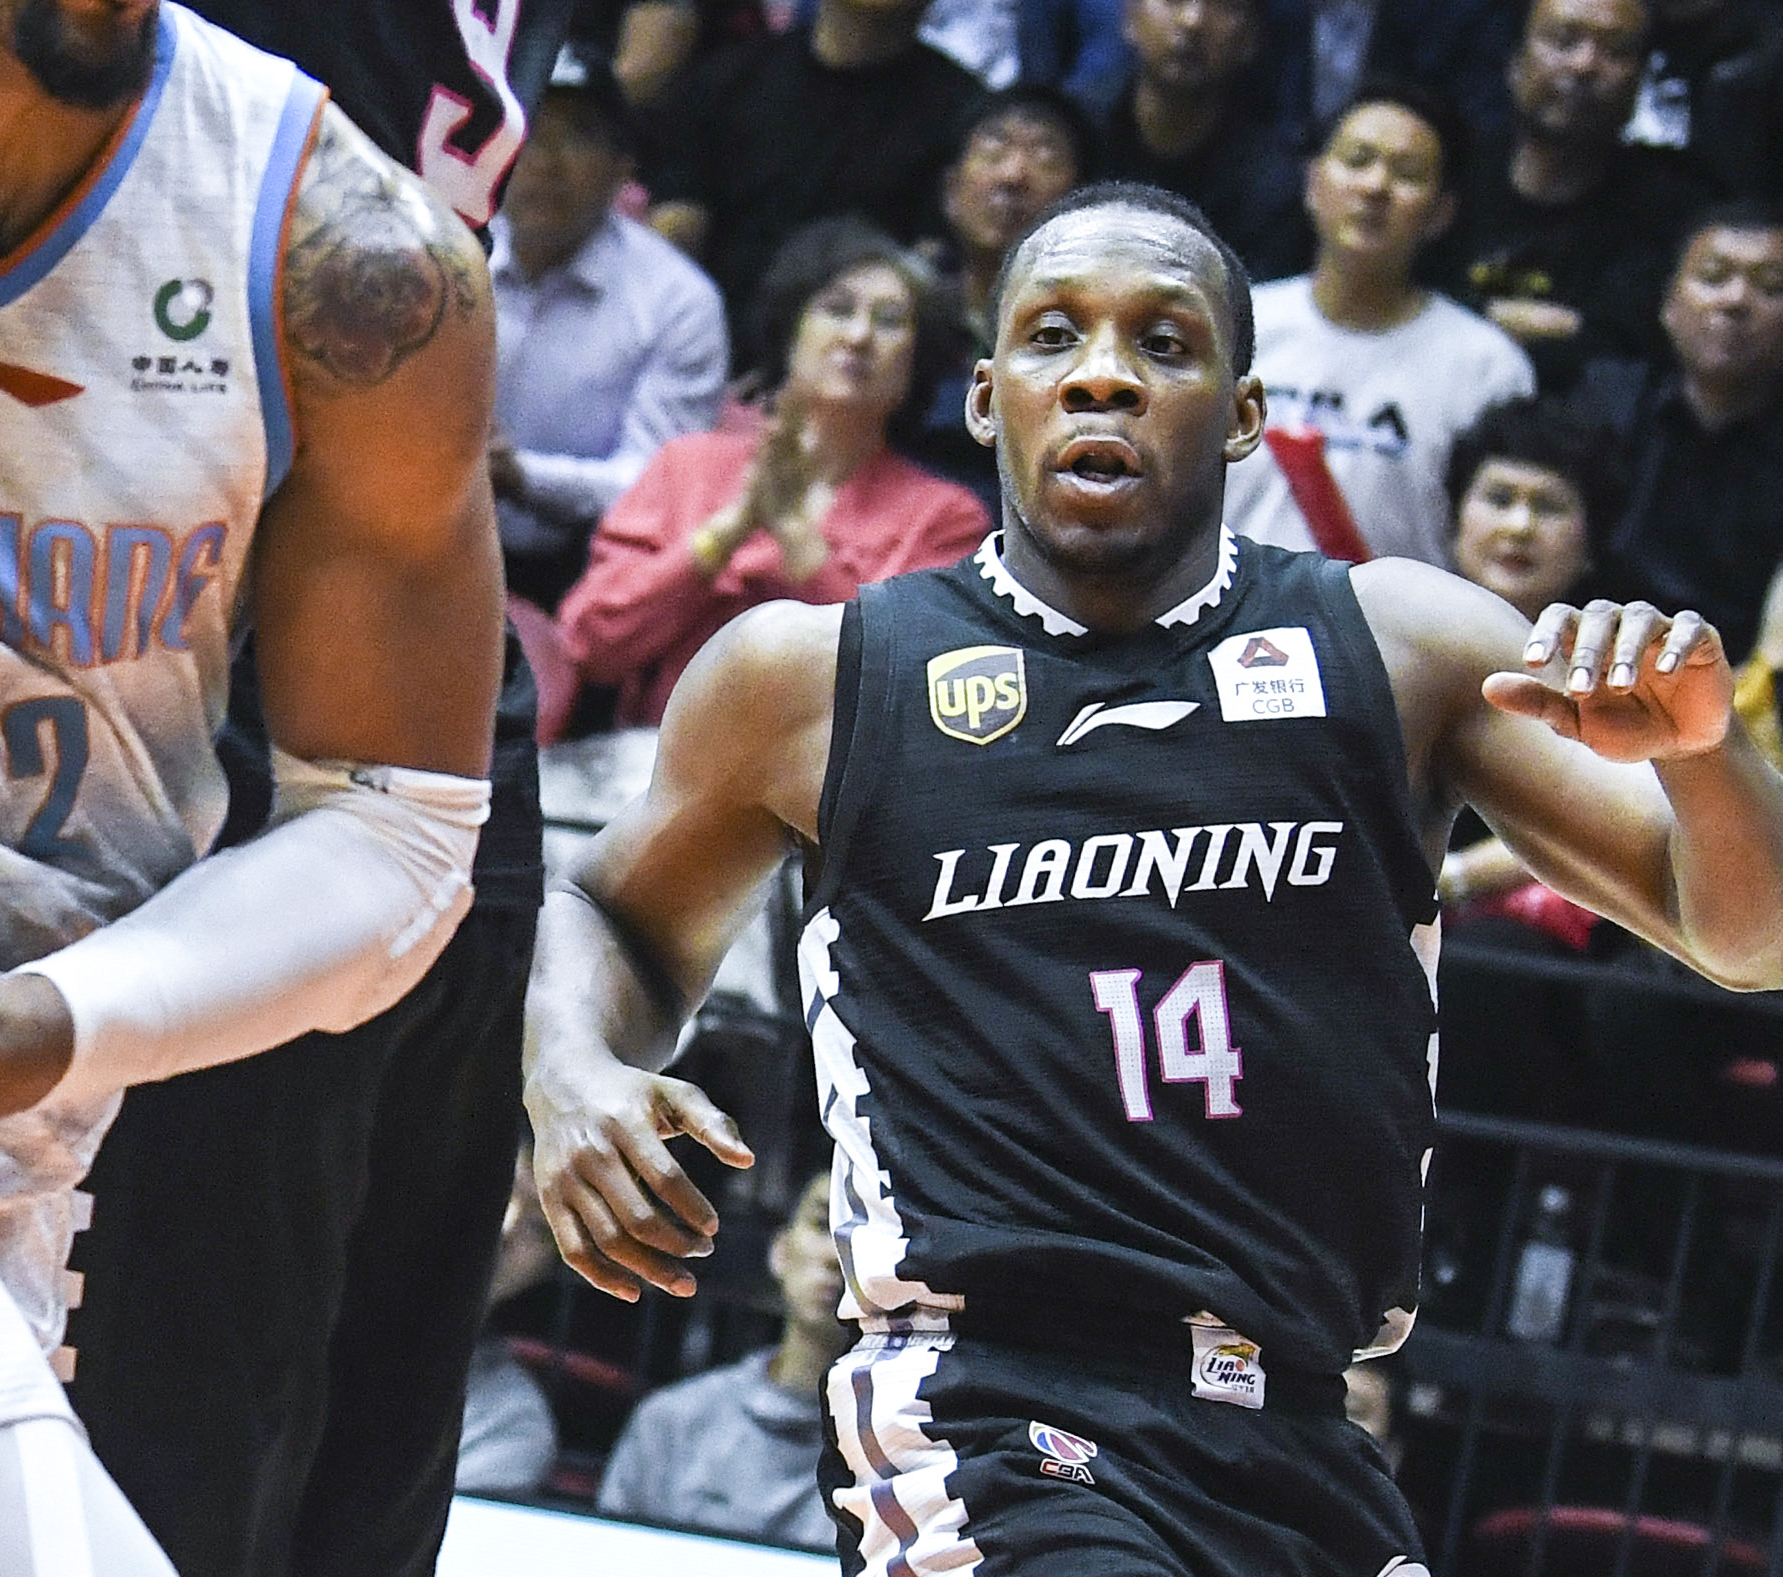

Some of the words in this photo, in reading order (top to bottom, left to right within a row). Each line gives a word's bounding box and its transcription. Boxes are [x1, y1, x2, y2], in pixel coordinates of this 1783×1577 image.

[935, 670, 1020, 729] ups
[1235, 678, 1305, 697] 广发银行
[1252, 697, 1295, 715] CGB
[1, 695, 90, 860] 2
[921, 821, 1344, 923] LIAONING
[1088, 959, 1243, 1123] 14
[1218, 1371, 1256, 1386] NING
